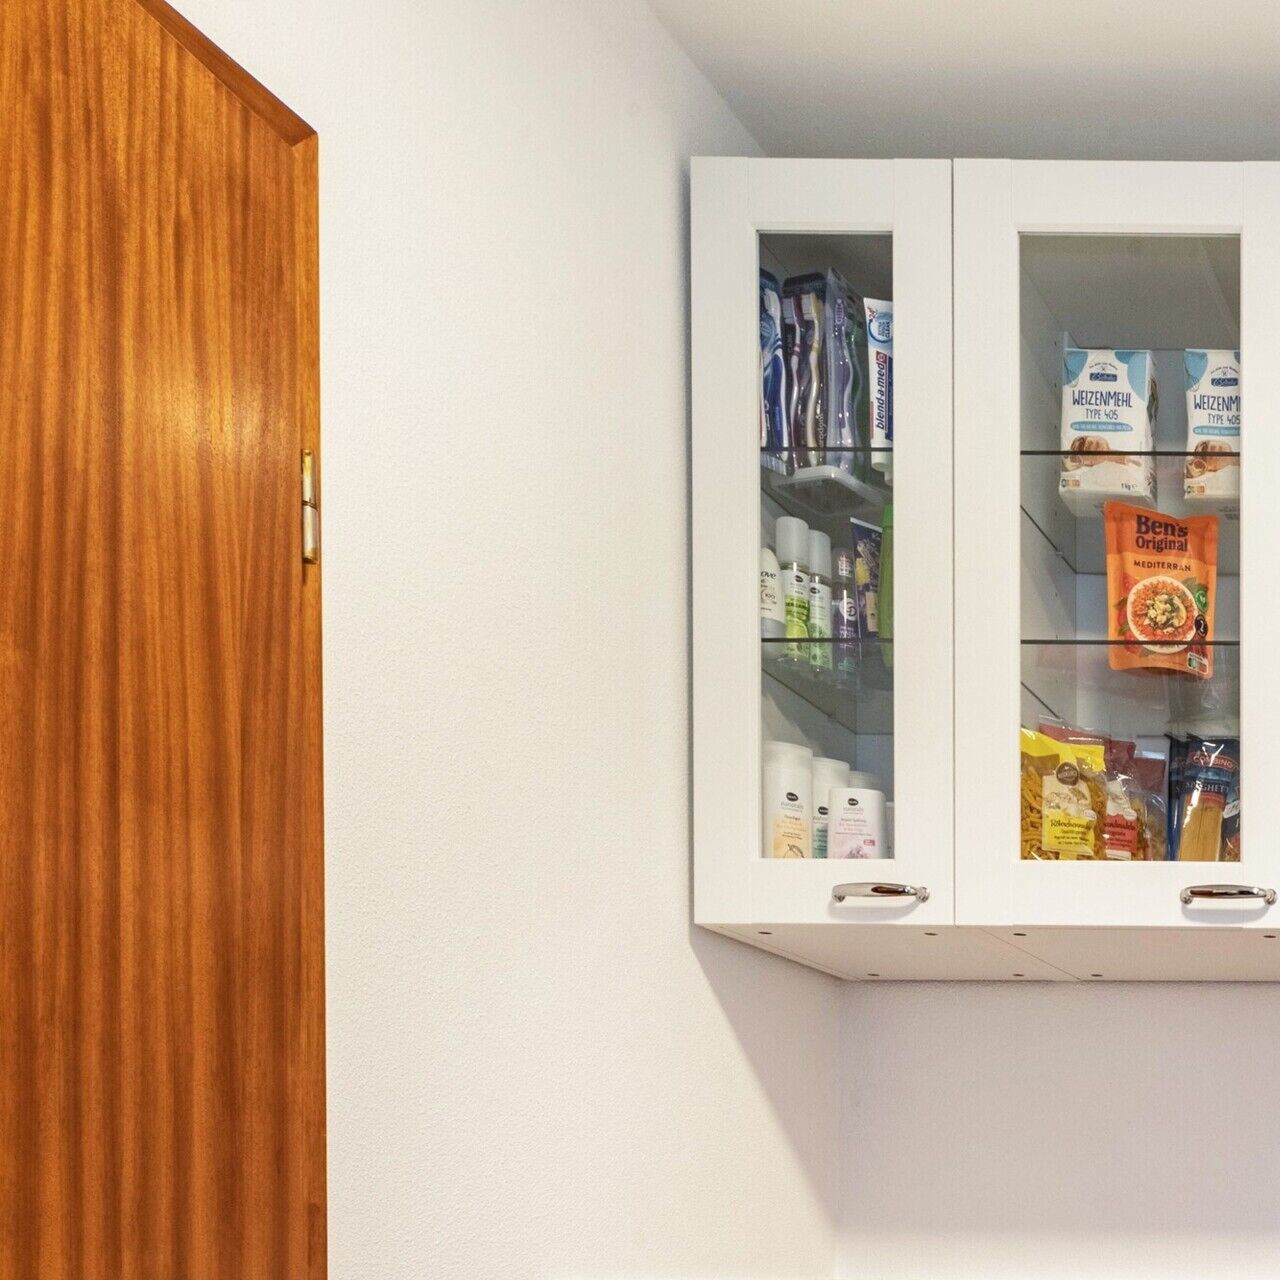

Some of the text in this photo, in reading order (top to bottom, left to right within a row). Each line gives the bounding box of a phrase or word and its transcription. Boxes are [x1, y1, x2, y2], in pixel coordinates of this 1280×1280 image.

[875, 362, 885, 430] blend-a-med
[1072, 390, 1133, 408] WEIZENMEHL
[1193, 394, 1240, 412] WEIZENM
[1085, 408, 1119, 420] TYPE 405
[1208, 414, 1240, 426] TYPE 405
[1136, 514, 1188, 537] Ben's
[1136, 535, 1188, 553] Original
[1134, 560, 1191, 572] MEDITERRAN
